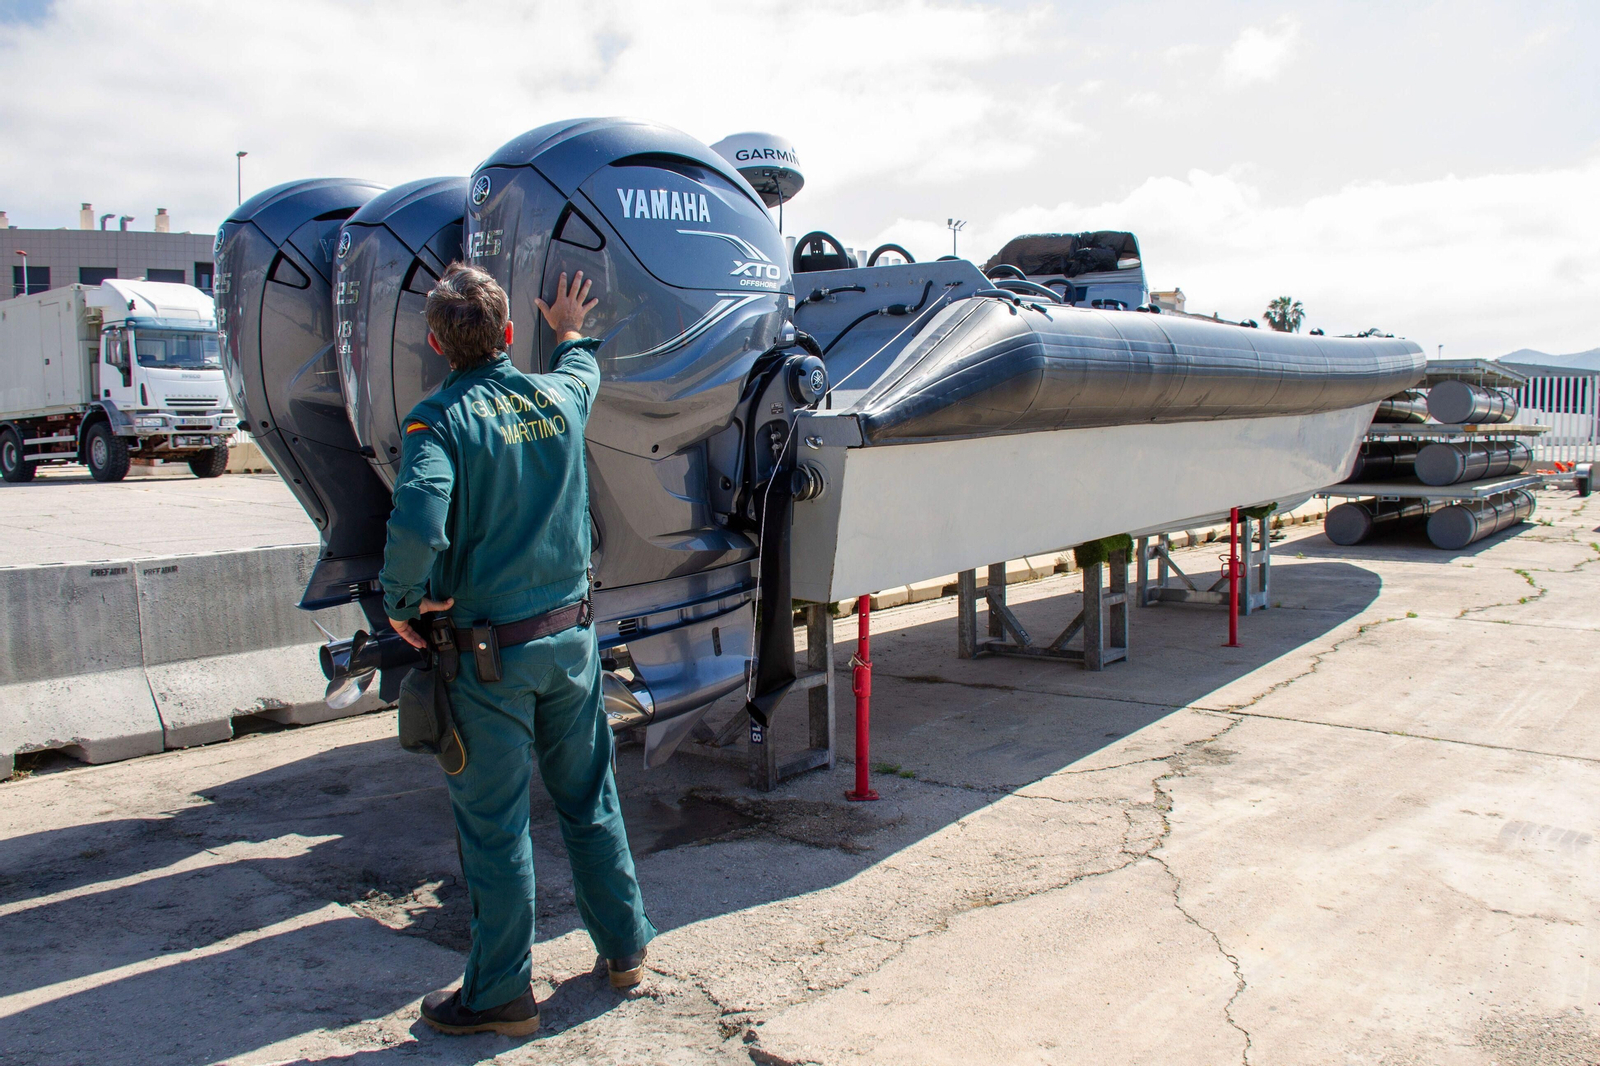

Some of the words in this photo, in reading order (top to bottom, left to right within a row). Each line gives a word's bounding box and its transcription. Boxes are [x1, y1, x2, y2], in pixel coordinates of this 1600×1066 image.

[735, 148, 800, 166] GARMIN
[616, 188, 711, 223] YAMAHA
[729, 260, 781, 280] XTO
[739, 279, 777, 289] OFFSHORE
[471, 393, 533, 418] GUARDIA
[534, 387, 566, 409] CIVIL
[500, 415, 566, 445] MARÍTIMO
